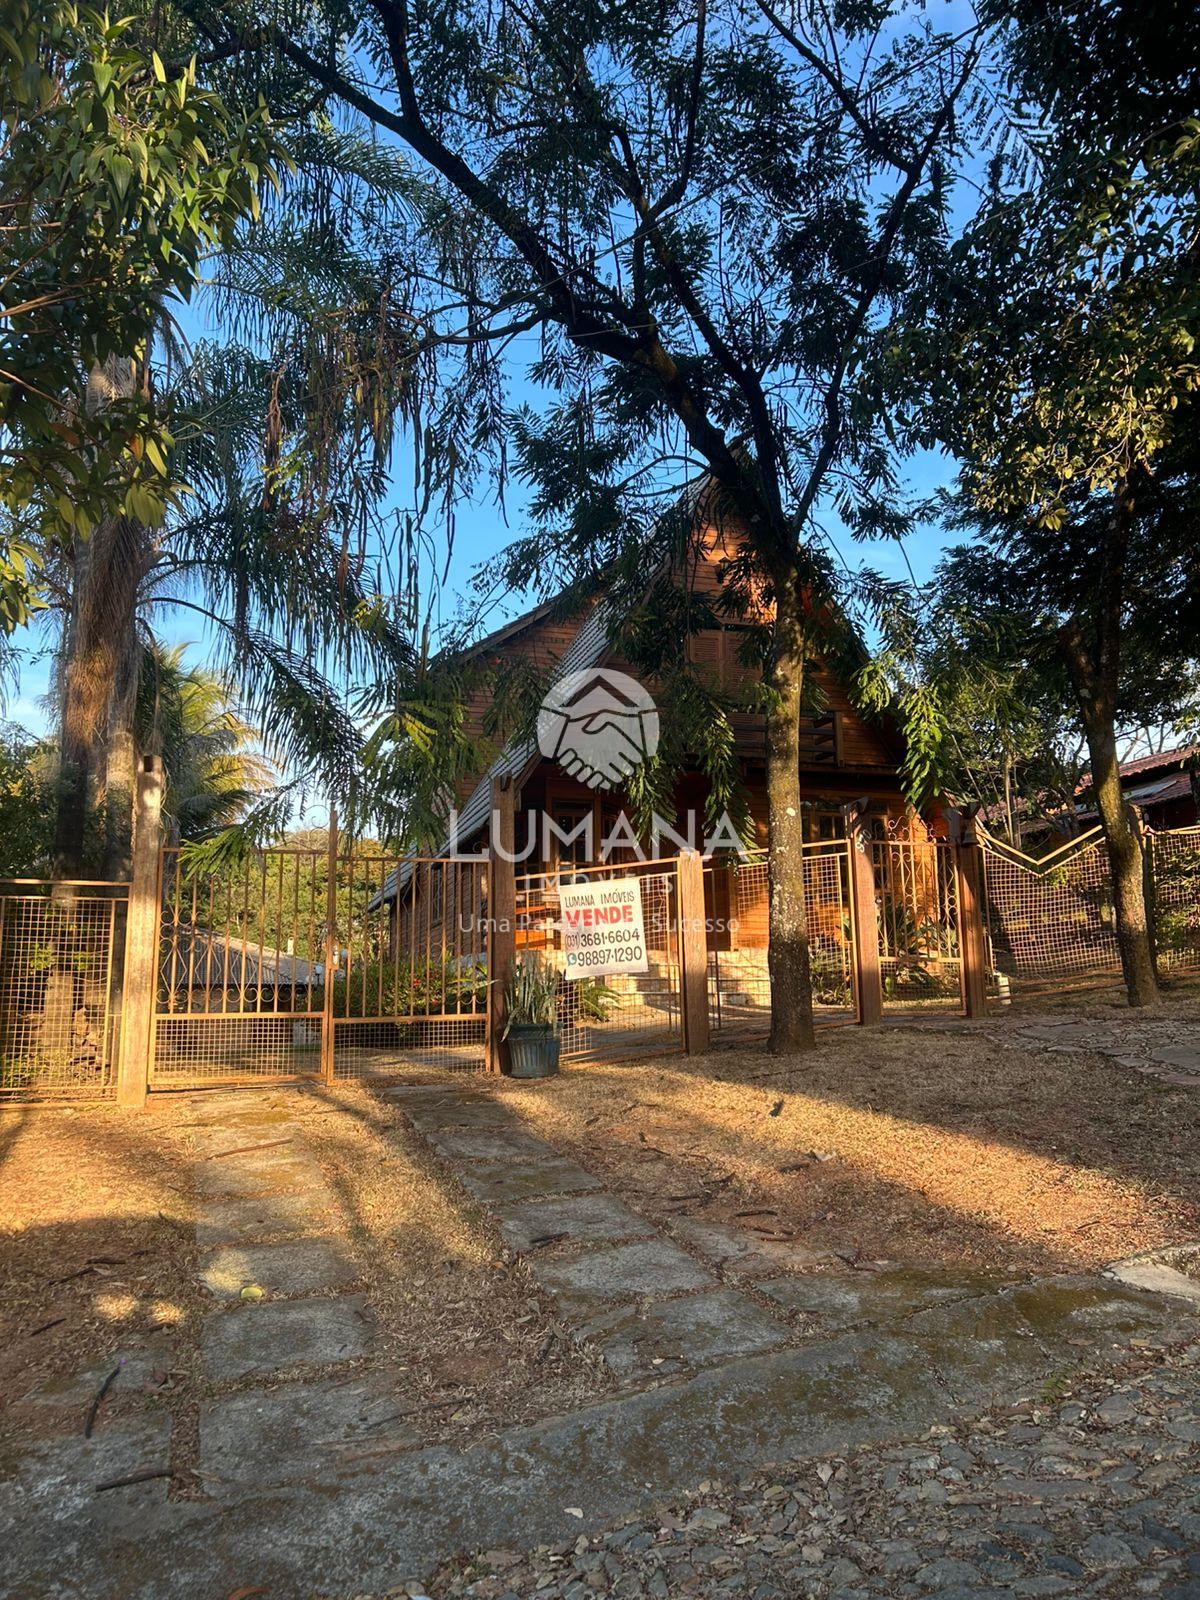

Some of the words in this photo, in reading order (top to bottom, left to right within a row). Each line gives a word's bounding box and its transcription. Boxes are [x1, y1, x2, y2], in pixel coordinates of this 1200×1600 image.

[565, 894, 595, 908] LUMANA
[600, 888, 635, 905] IMÓVEIS
[564, 905, 634, 928] VENDE
